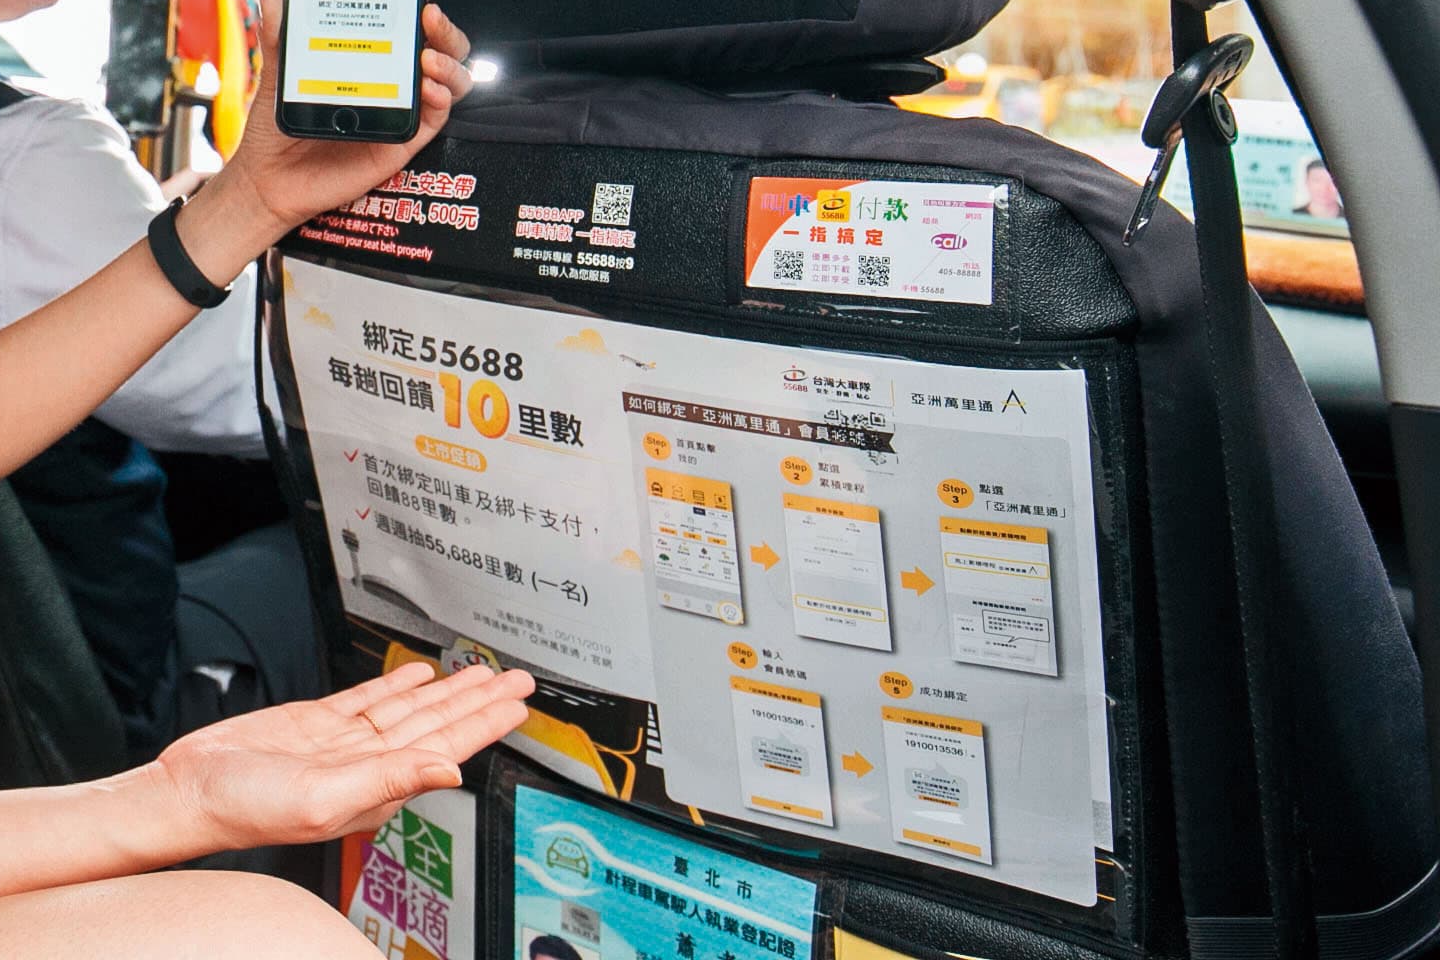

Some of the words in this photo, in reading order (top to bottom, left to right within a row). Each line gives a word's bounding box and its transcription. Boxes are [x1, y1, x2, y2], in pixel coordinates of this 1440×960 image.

[518, 205, 585, 223] 55688APP
[821, 211, 845, 220] 55688
[856, 196, 909, 222] 付款
[515, 221, 573, 242] 叫車付款
[575, 226, 636, 248] 一指搞定
[783, 226, 883, 246] 一指搞定
[933, 233, 965, 250] call
[300, 226, 322, 240] Please
[323, 229, 345, 244] fasten
[345, 236, 363, 248] your
[363, 239, 379, 251] seat
[380, 240, 396, 253] belt
[397, 245, 433, 262] properly
[938, 268, 982, 278] 405-88888
[920, 286, 945, 295] 55688
[362, 320, 523, 381] 綁定55688
[783, 383, 808, 392] 55688
[813, 375, 871, 392] 台灣大車隊
[911, 392, 994, 412] 亞洲萬里通
[646, 436, 667, 448] Step
[784, 461, 807, 472] Step
[942, 483, 968, 495] Step
[979, 484, 1003, 495] 點選
[986, 500, 1066, 518] 「亞洲萬里通」
[731, 645, 753, 658] Step
[884, 675, 908, 687] Step
[920, 686, 968, 702] 成功綁定
[904, 739, 964, 757] 1910013536
[674, 846, 753, 899] 臺北市
[605, 869, 796, 959] 計程車駕駛人執業登記證
